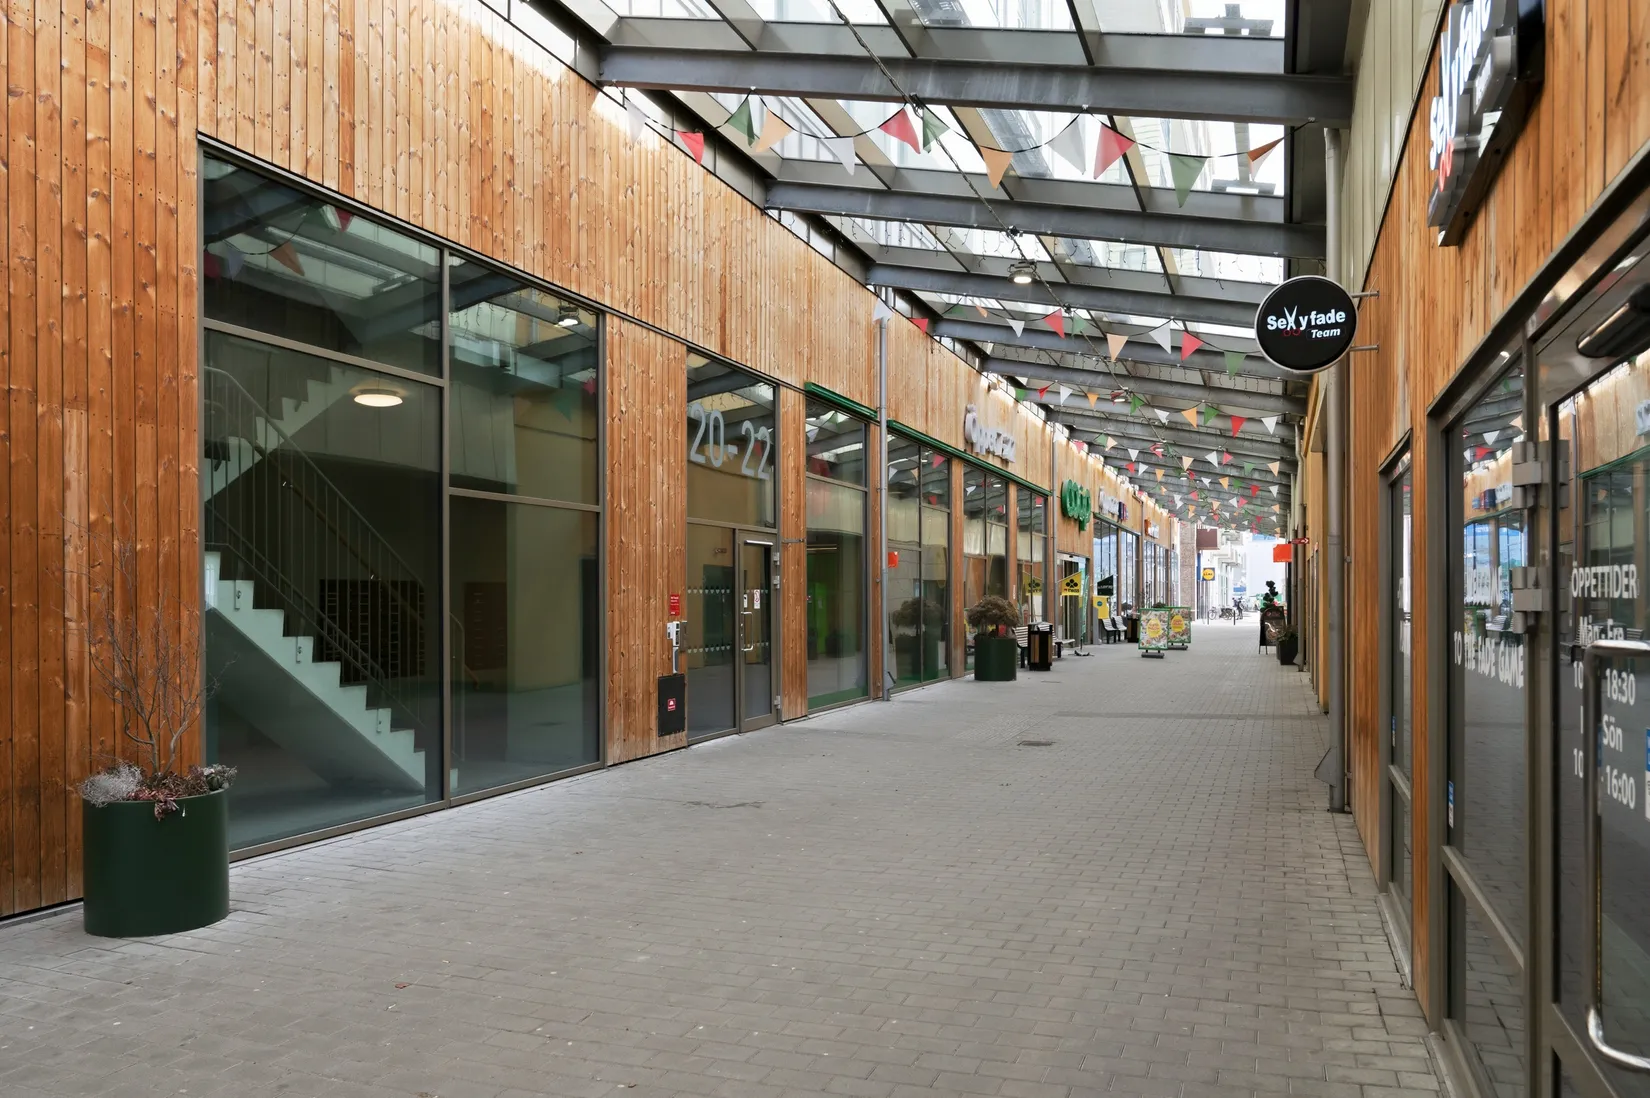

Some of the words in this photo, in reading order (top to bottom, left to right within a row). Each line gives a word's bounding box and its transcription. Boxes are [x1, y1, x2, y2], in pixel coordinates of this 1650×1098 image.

[1311, 328, 1341, 338] Team
[690, 403, 770, 480] 20-22
[1571, 561, 1638, 599] ÖPPETTIDER
[1454, 630, 1463, 666] TO
[1478, 635, 1496, 678] FADE
[1499, 640, 1524, 689] GAME
[1605, 668, 1636, 706] 18:30
[1602, 714, 1623, 752] Sön
[1606, 765, 1636, 809] 16:00
